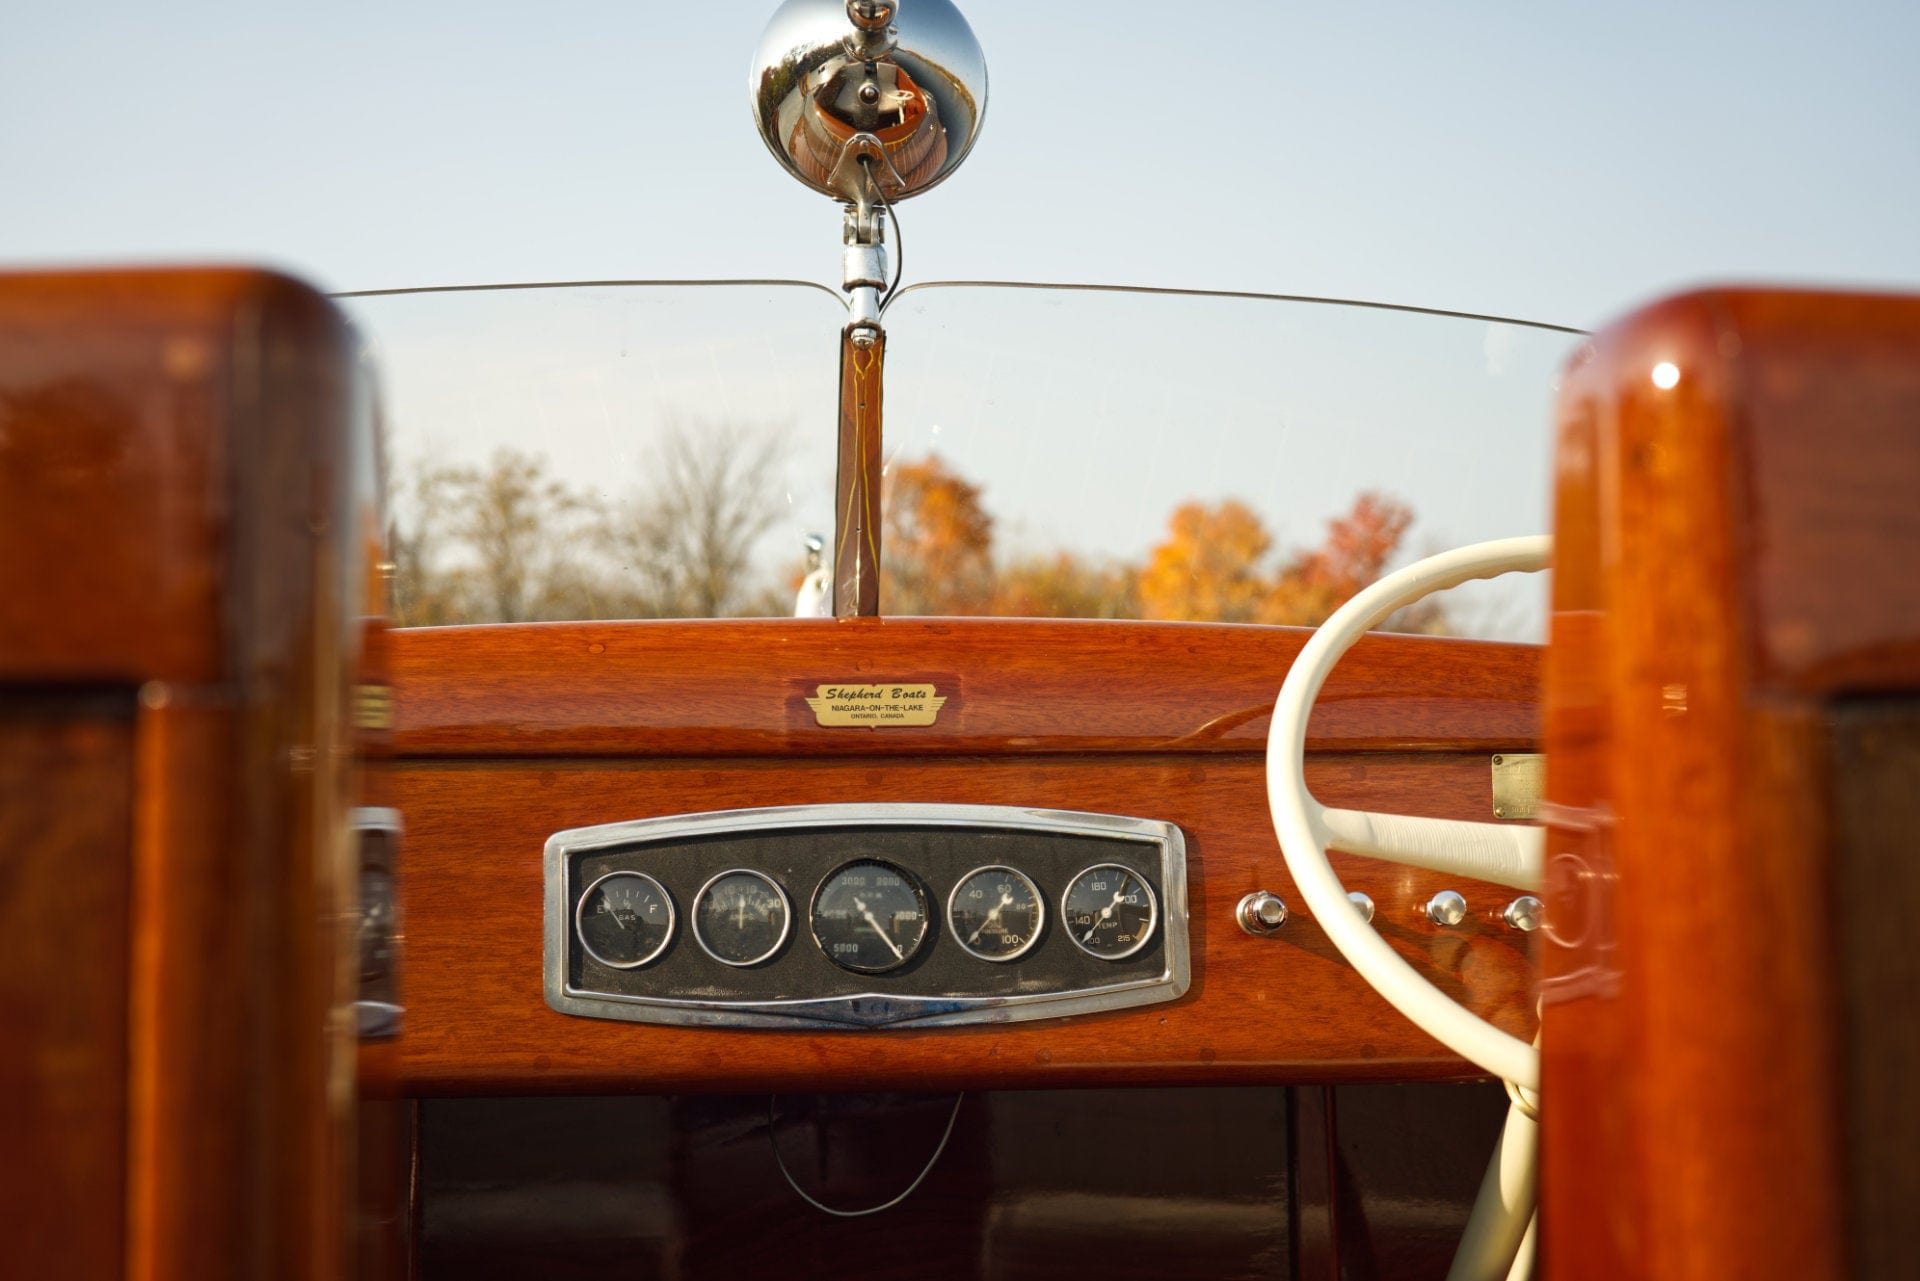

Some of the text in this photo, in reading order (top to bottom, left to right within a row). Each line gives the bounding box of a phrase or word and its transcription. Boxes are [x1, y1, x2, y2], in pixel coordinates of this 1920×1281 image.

[825, 687, 927, 701] Shepherd Boats
[831, 704, 924, 712] NIAGARA-ON-THE-LAKE
[841, 877, 866, 887] 3000
[1091, 881, 1107, 891] 180
[997, 884, 1012, 894] 60
[969, 890, 983, 899] 40
[767, 899, 781, 908] 30
[597, 904, 604, 914] E
[649, 904, 658, 914] F
[1075, 915, 1091, 925] 140
[1099, 921, 1118, 930] TEMP
[1002, 934, 1019, 944] 100
[1117, 934, 1131, 942] 215
[833, 943, 859, 953] 5000
